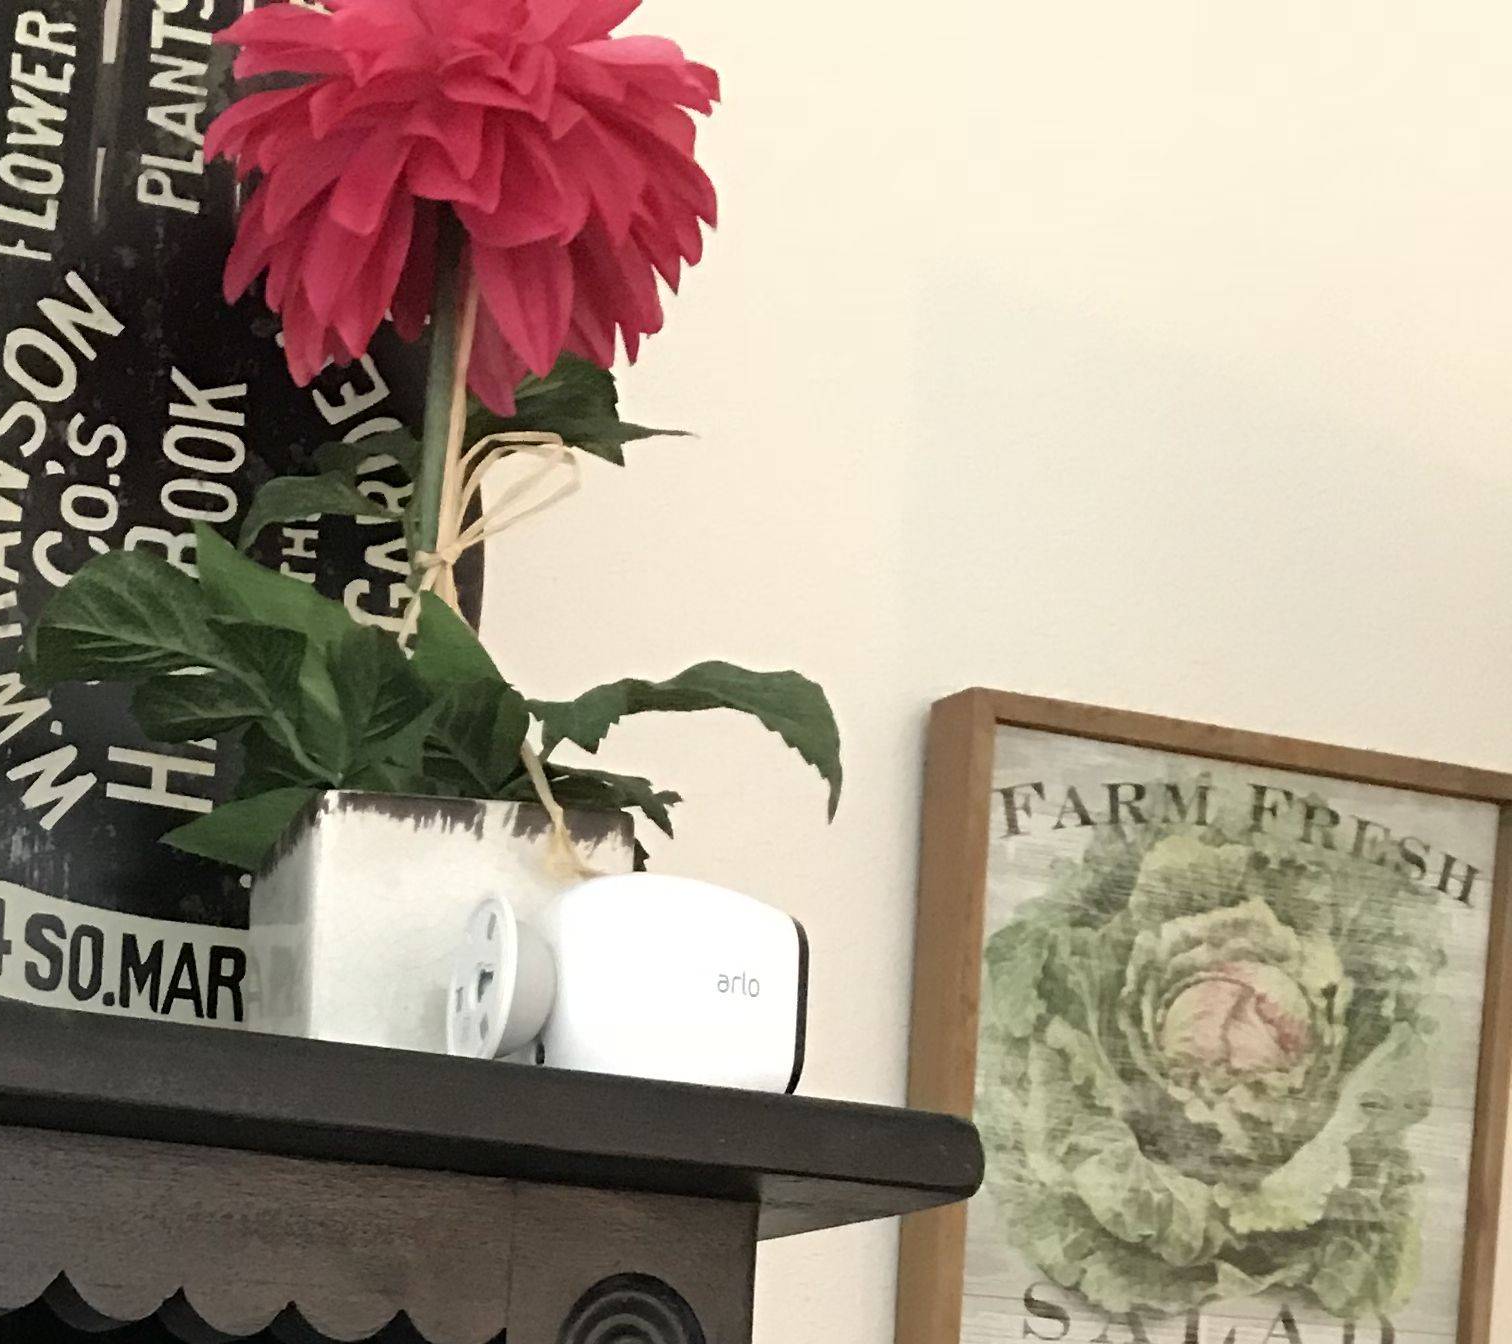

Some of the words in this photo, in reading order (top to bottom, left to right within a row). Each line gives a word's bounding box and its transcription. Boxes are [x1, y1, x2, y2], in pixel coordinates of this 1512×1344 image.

[995, 780, 1212, 840] FARM
[1248, 782, 1479, 906] FRESH
[717, 971, 760, 998] arlo
